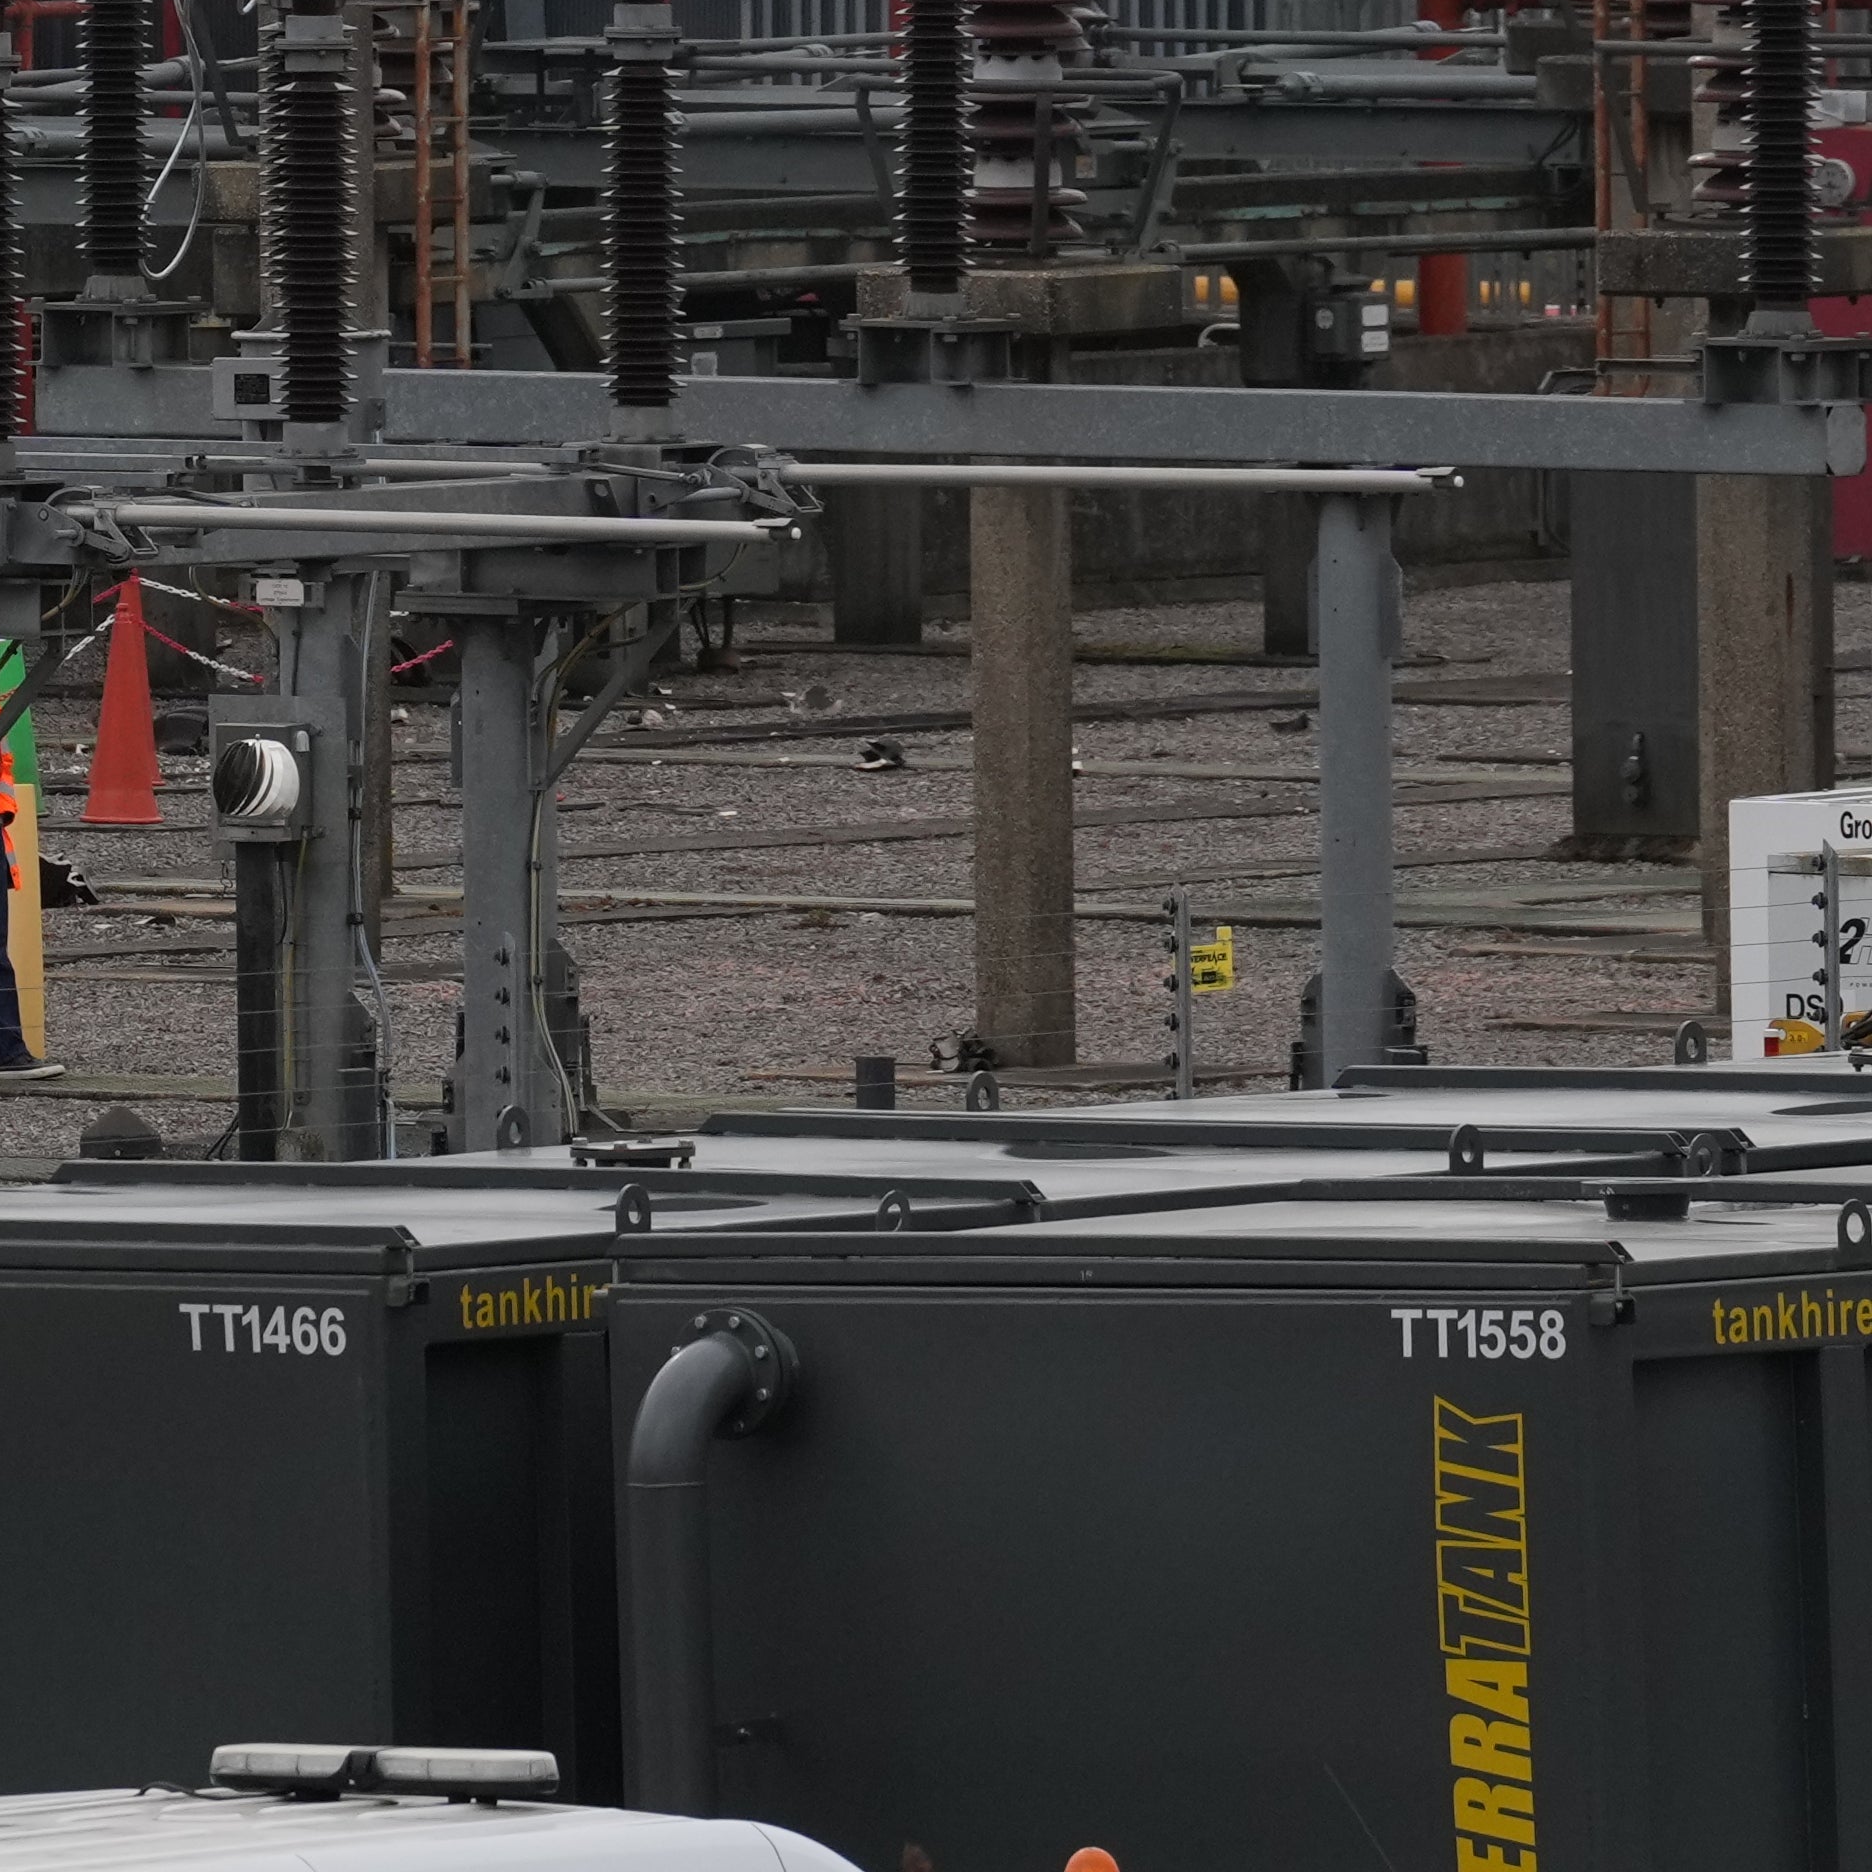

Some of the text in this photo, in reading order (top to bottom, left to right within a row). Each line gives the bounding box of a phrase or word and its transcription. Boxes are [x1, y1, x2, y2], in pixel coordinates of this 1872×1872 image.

[459, 1273, 597, 1329] tankhir
[179, 1303, 346, 1356] TT1466
[1391, 1308, 1567, 1360] TT1558
[1434, 1394, 1537, 1872] ERRATANK
